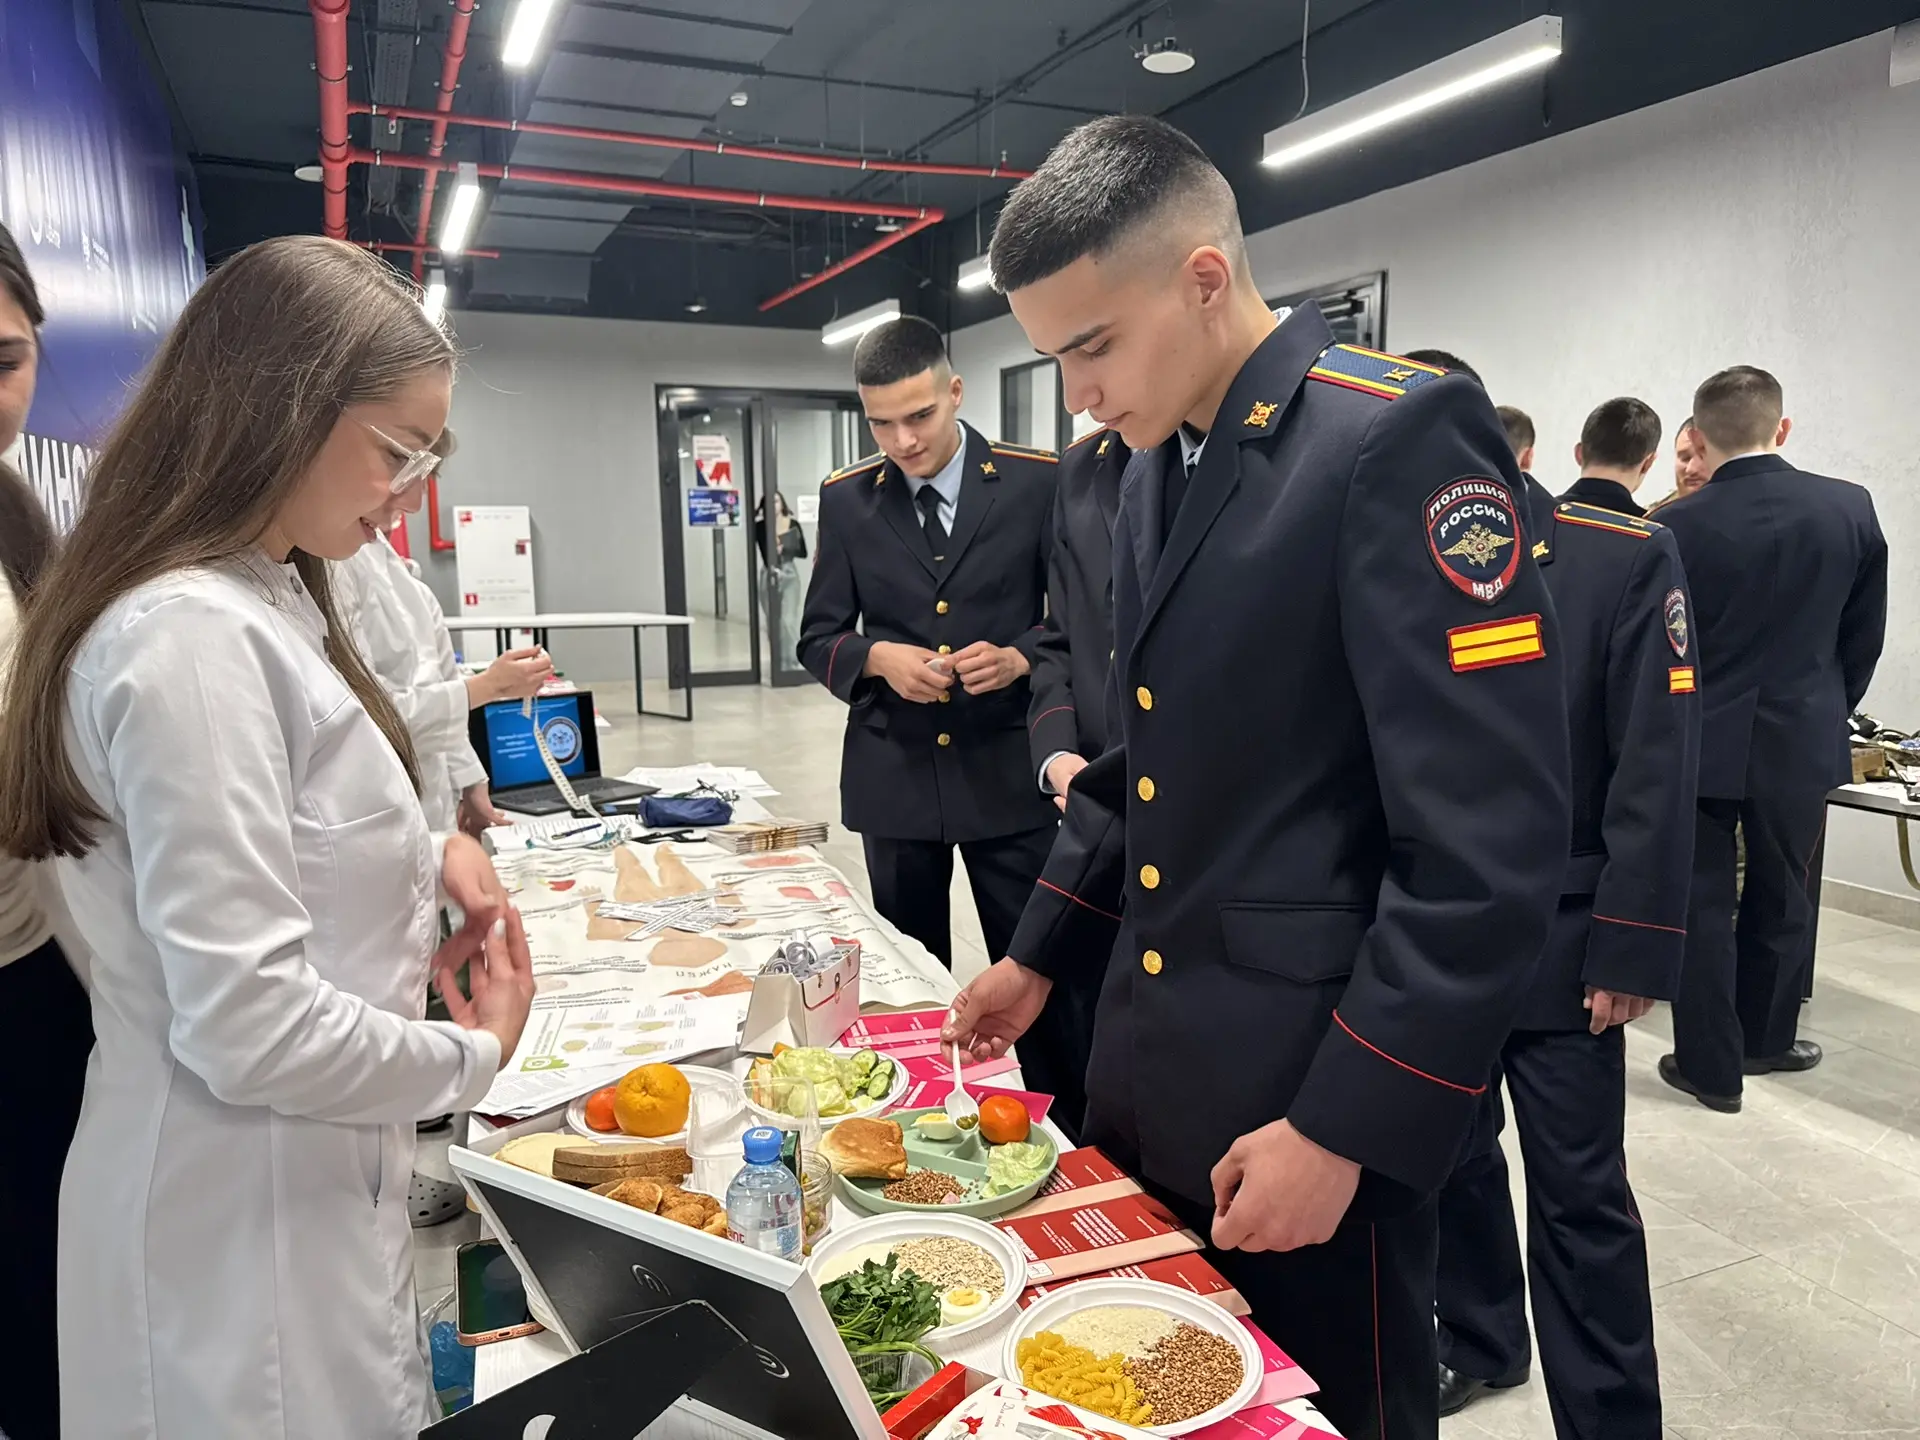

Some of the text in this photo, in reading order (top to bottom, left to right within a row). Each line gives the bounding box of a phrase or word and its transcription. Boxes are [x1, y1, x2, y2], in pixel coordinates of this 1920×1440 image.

[1429, 483, 1508, 519] ПОЛИЦИЯ
[1440, 503, 1507, 538] РОССИЯ
[1472, 576, 1503, 600] МВД
